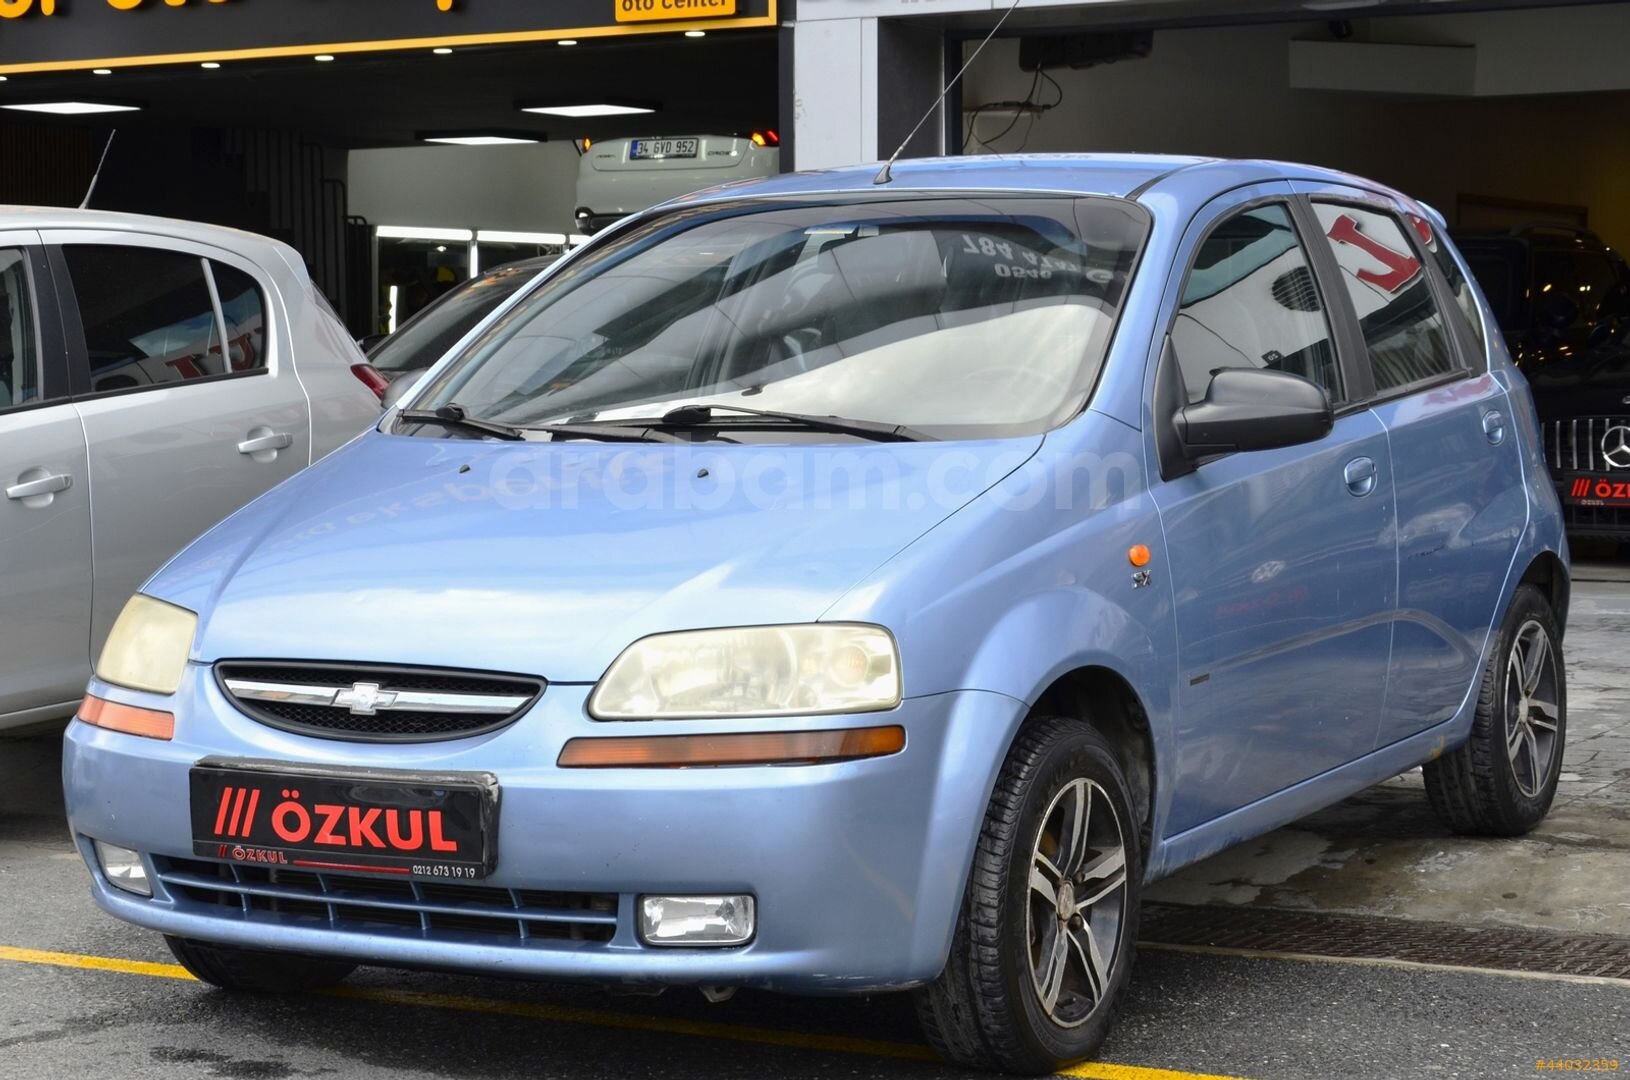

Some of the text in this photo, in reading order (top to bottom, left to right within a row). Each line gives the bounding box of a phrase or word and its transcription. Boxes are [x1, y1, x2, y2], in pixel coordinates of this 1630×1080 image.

[622, 0, 654, 12] oto
[637, 142, 649, 154] 34
[676, 140, 694, 153] 952
[271, 789, 458, 851] ÖZKUL
[232, 845, 288, 865] ÖZKUL
[412, 864, 476, 879] 0212 673 19 19
